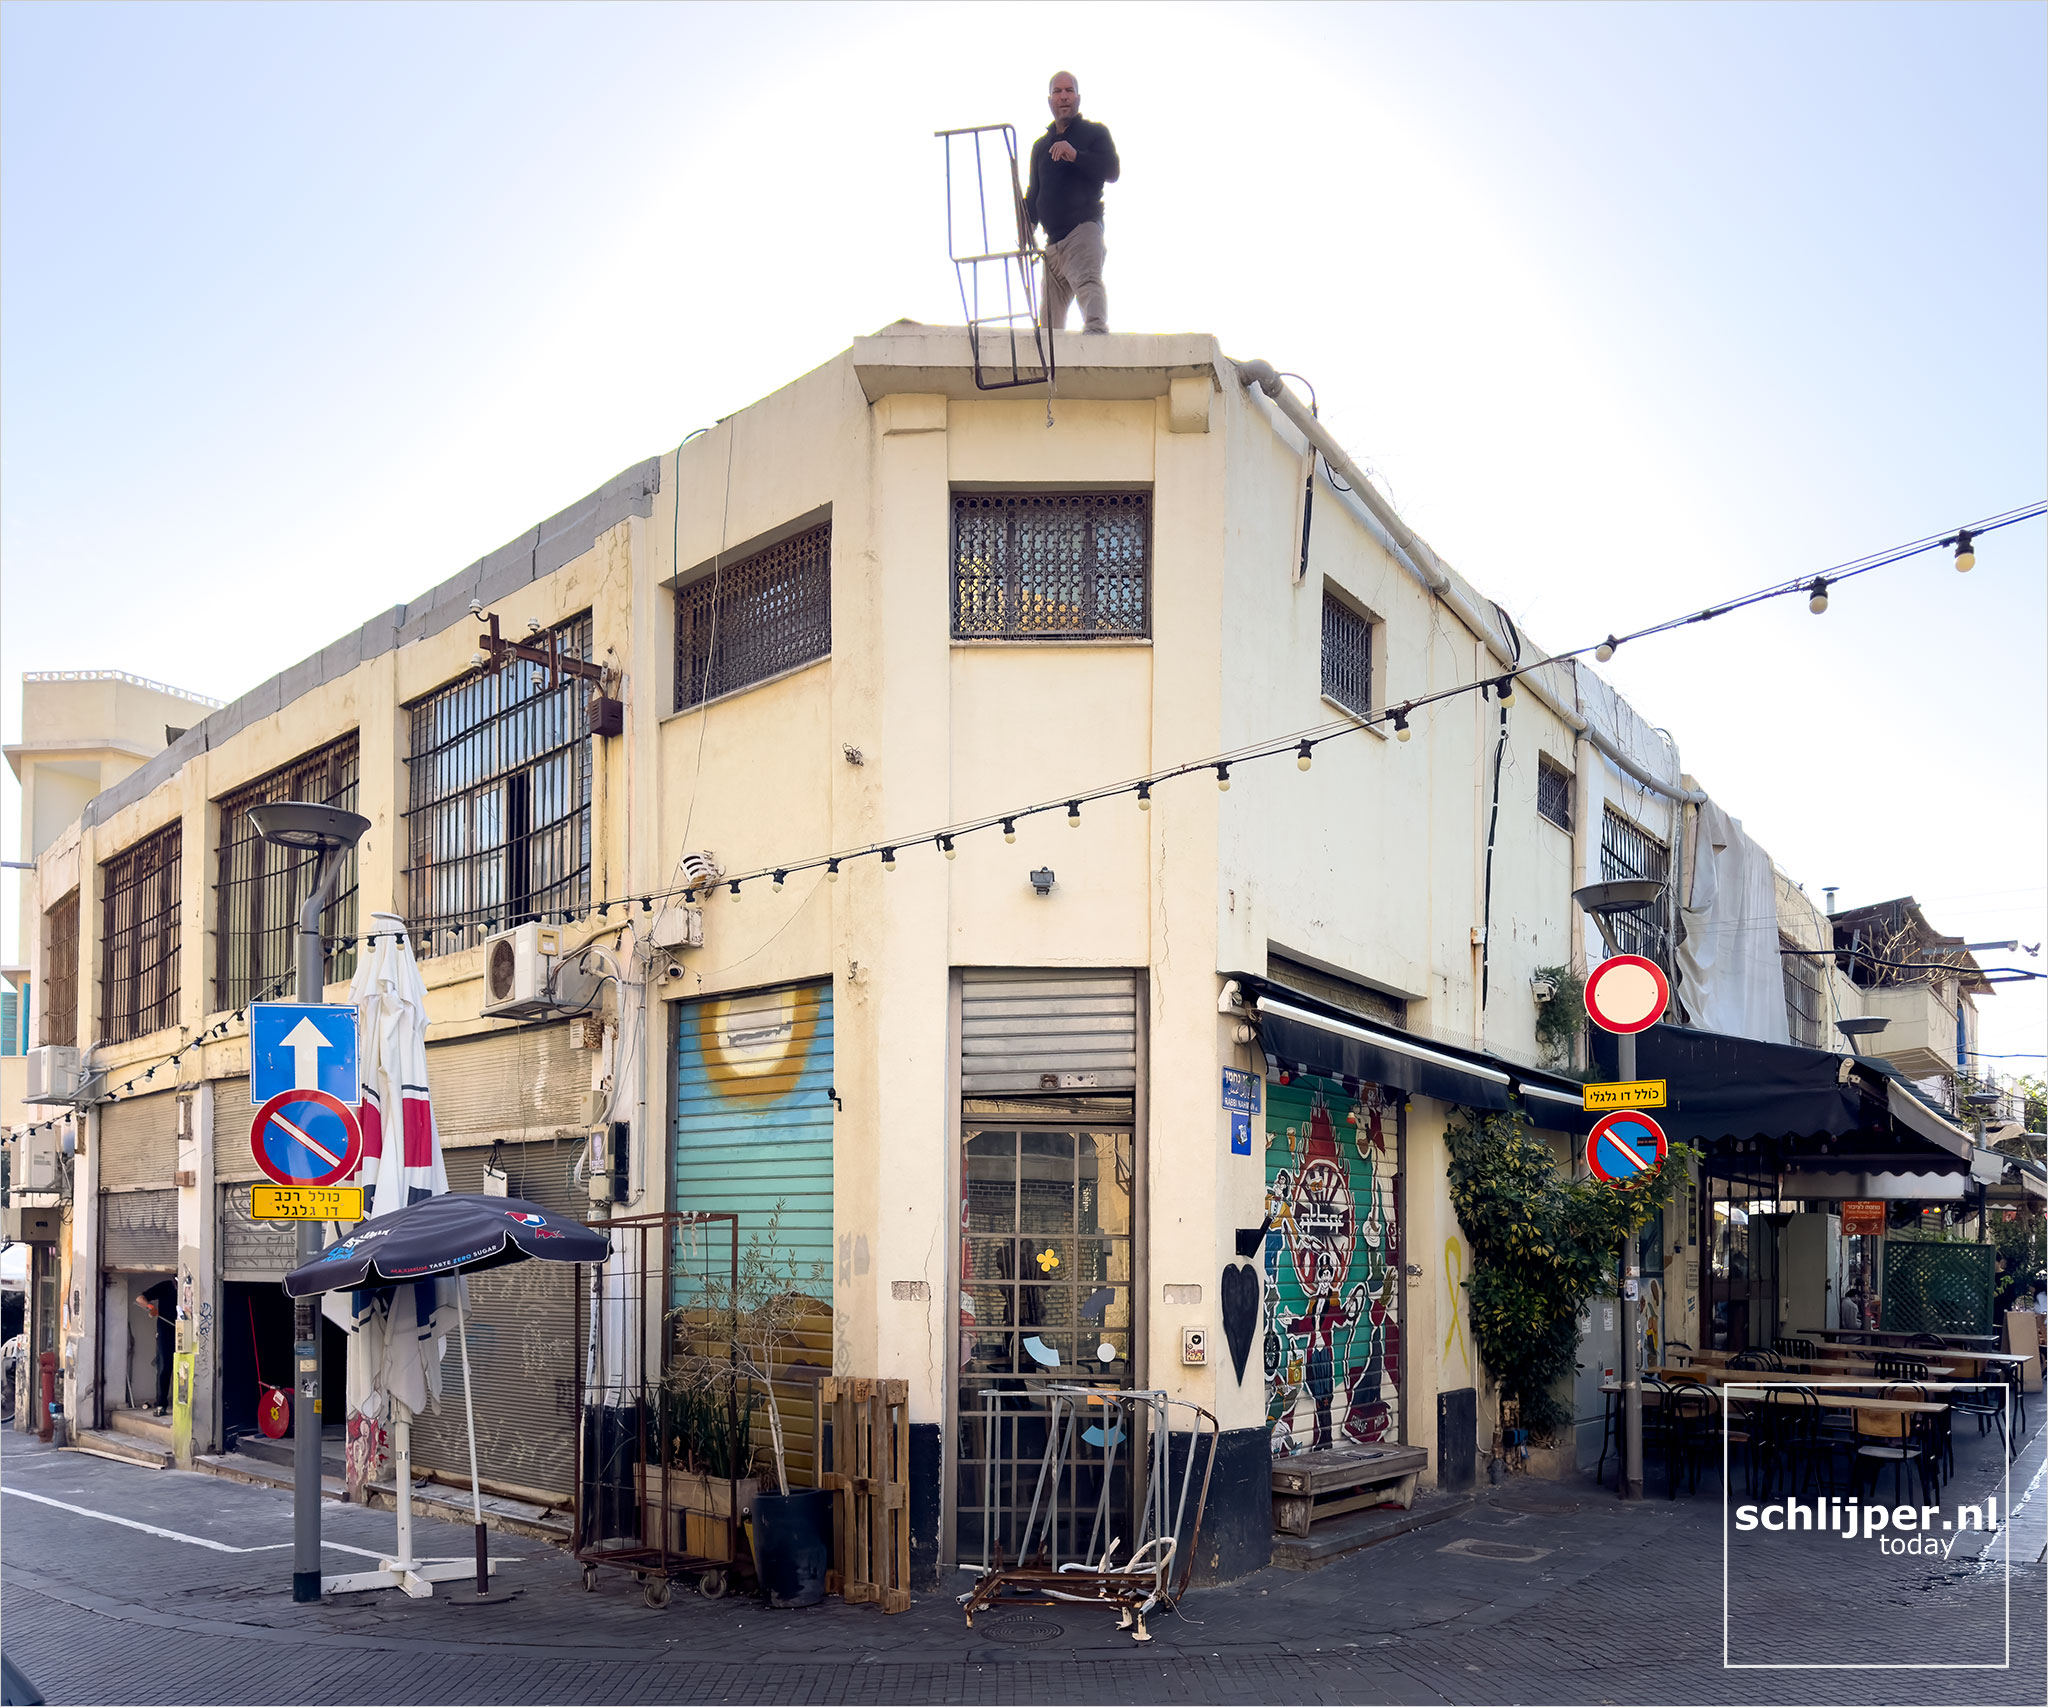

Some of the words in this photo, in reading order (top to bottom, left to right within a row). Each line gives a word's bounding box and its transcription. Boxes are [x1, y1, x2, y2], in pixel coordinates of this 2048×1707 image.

[1590, 1090, 1616, 1102] גלגלי
[1621, 1092, 1630, 1101] דו
[1635, 1088, 1659, 1100] כולל
[274, 1191, 300, 1202] רכב
[308, 1190, 340, 1202] כולל
[276, 1204, 316, 1216] גלגלי
[325, 1206, 338, 1216] דו
[390, 1265, 428, 1273] MAXIMUM
[429, 1260, 451, 1269] TASTE
[452, 1254, 471, 1264] ZERO
[473, 1245, 497, 1257] SUGAR
